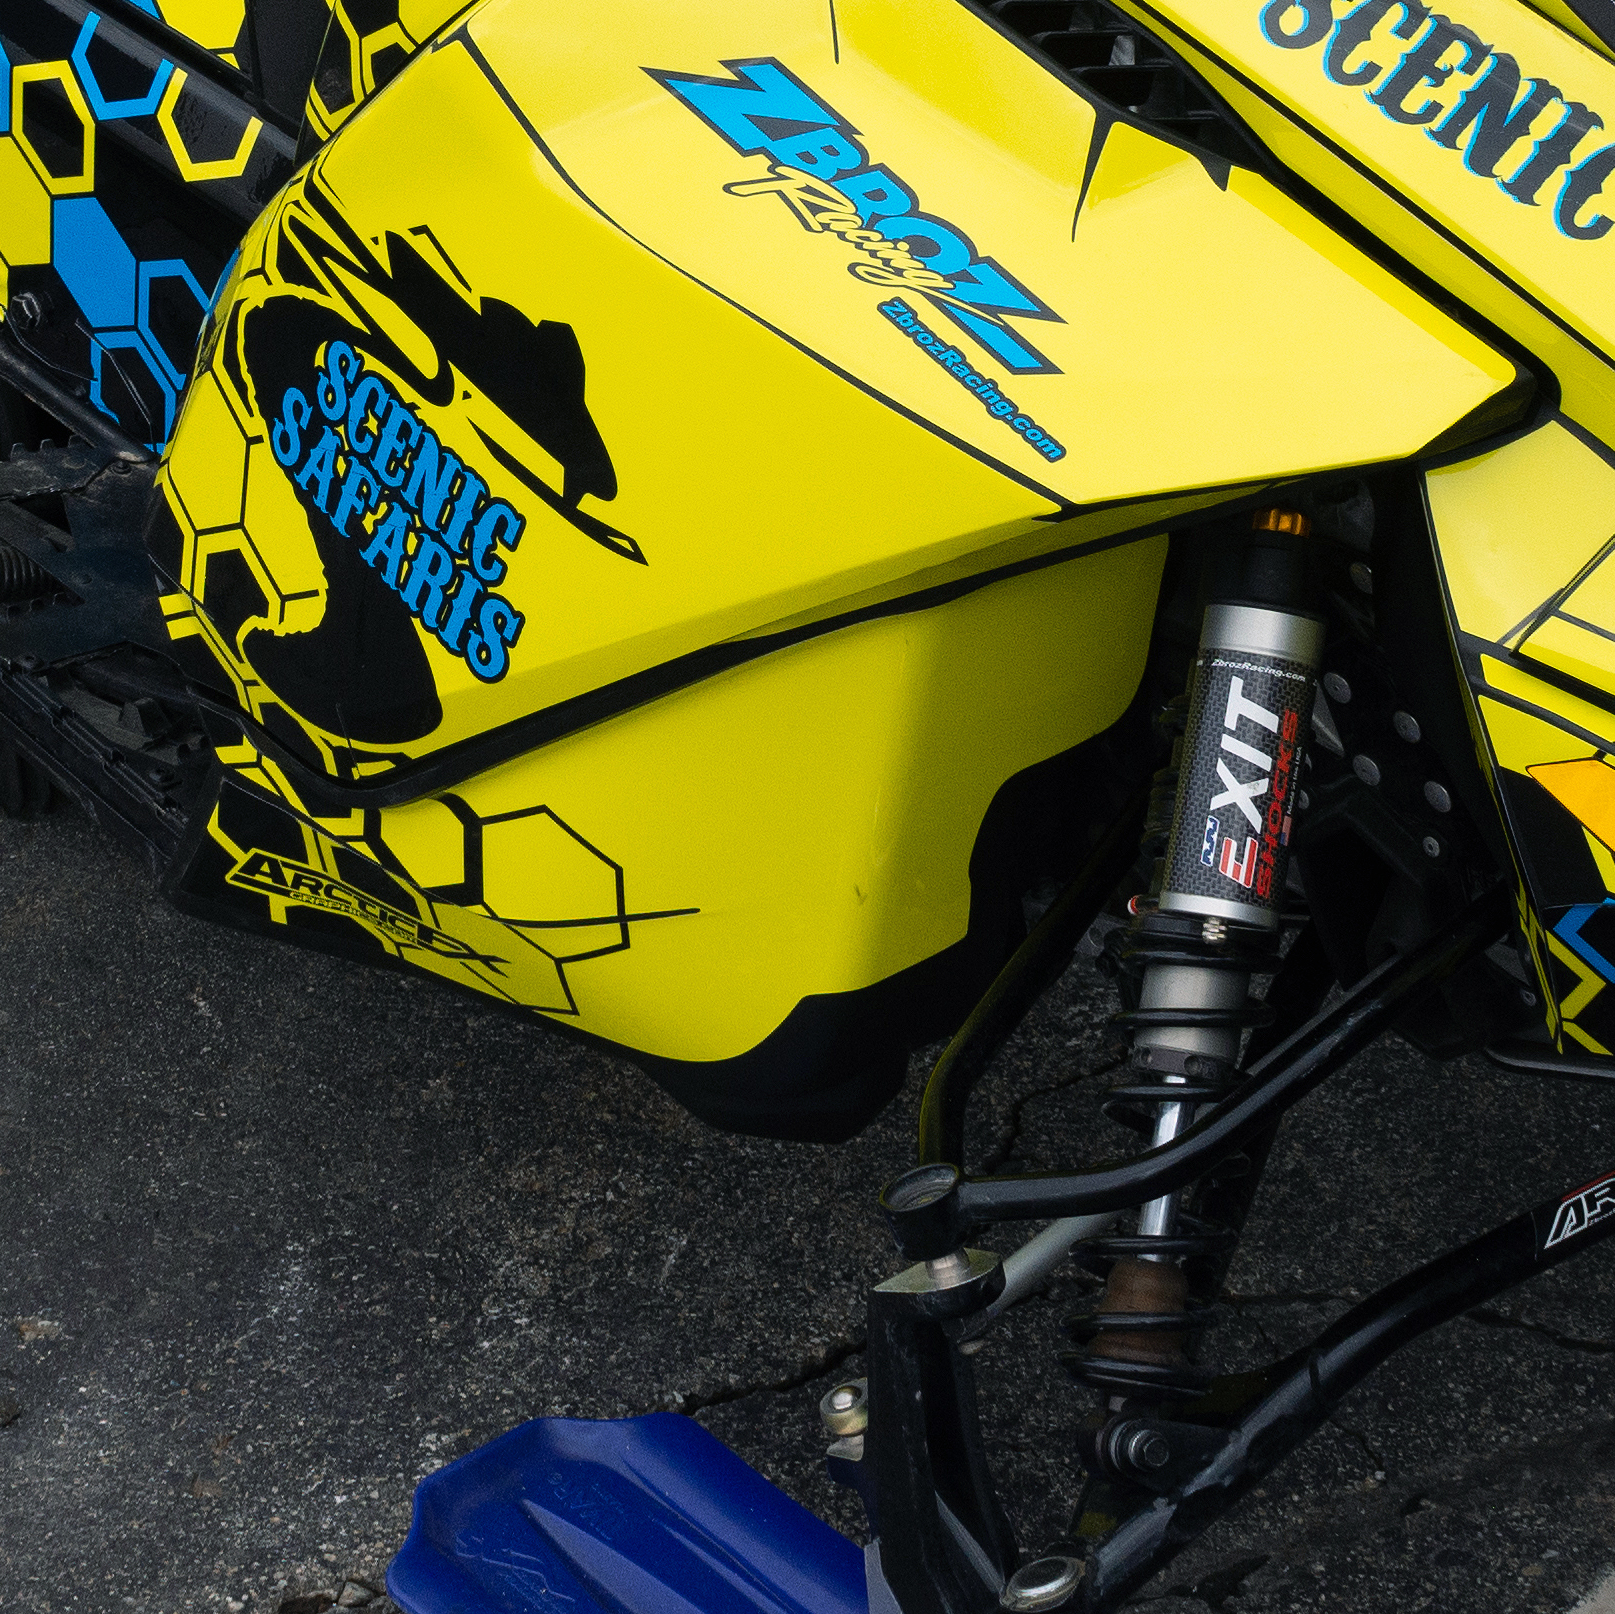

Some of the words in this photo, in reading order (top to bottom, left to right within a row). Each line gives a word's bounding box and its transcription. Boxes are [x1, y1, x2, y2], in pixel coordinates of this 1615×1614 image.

[640, 56, 1068, 375] ZBROZ
[723, 163, 1006, 326] Racing
[317, 340, 525, 582] SCENIC
[880, 298, 1065, 461] ZbrozRacing.com
[273, 386, 525, 683] SAFARIS
[1211, 658, 1306, 683] ZbrozRacing.com
[1200, 676, 1280, 889] EXIT
[1255, 708, 1298, 900] SHOCKS
